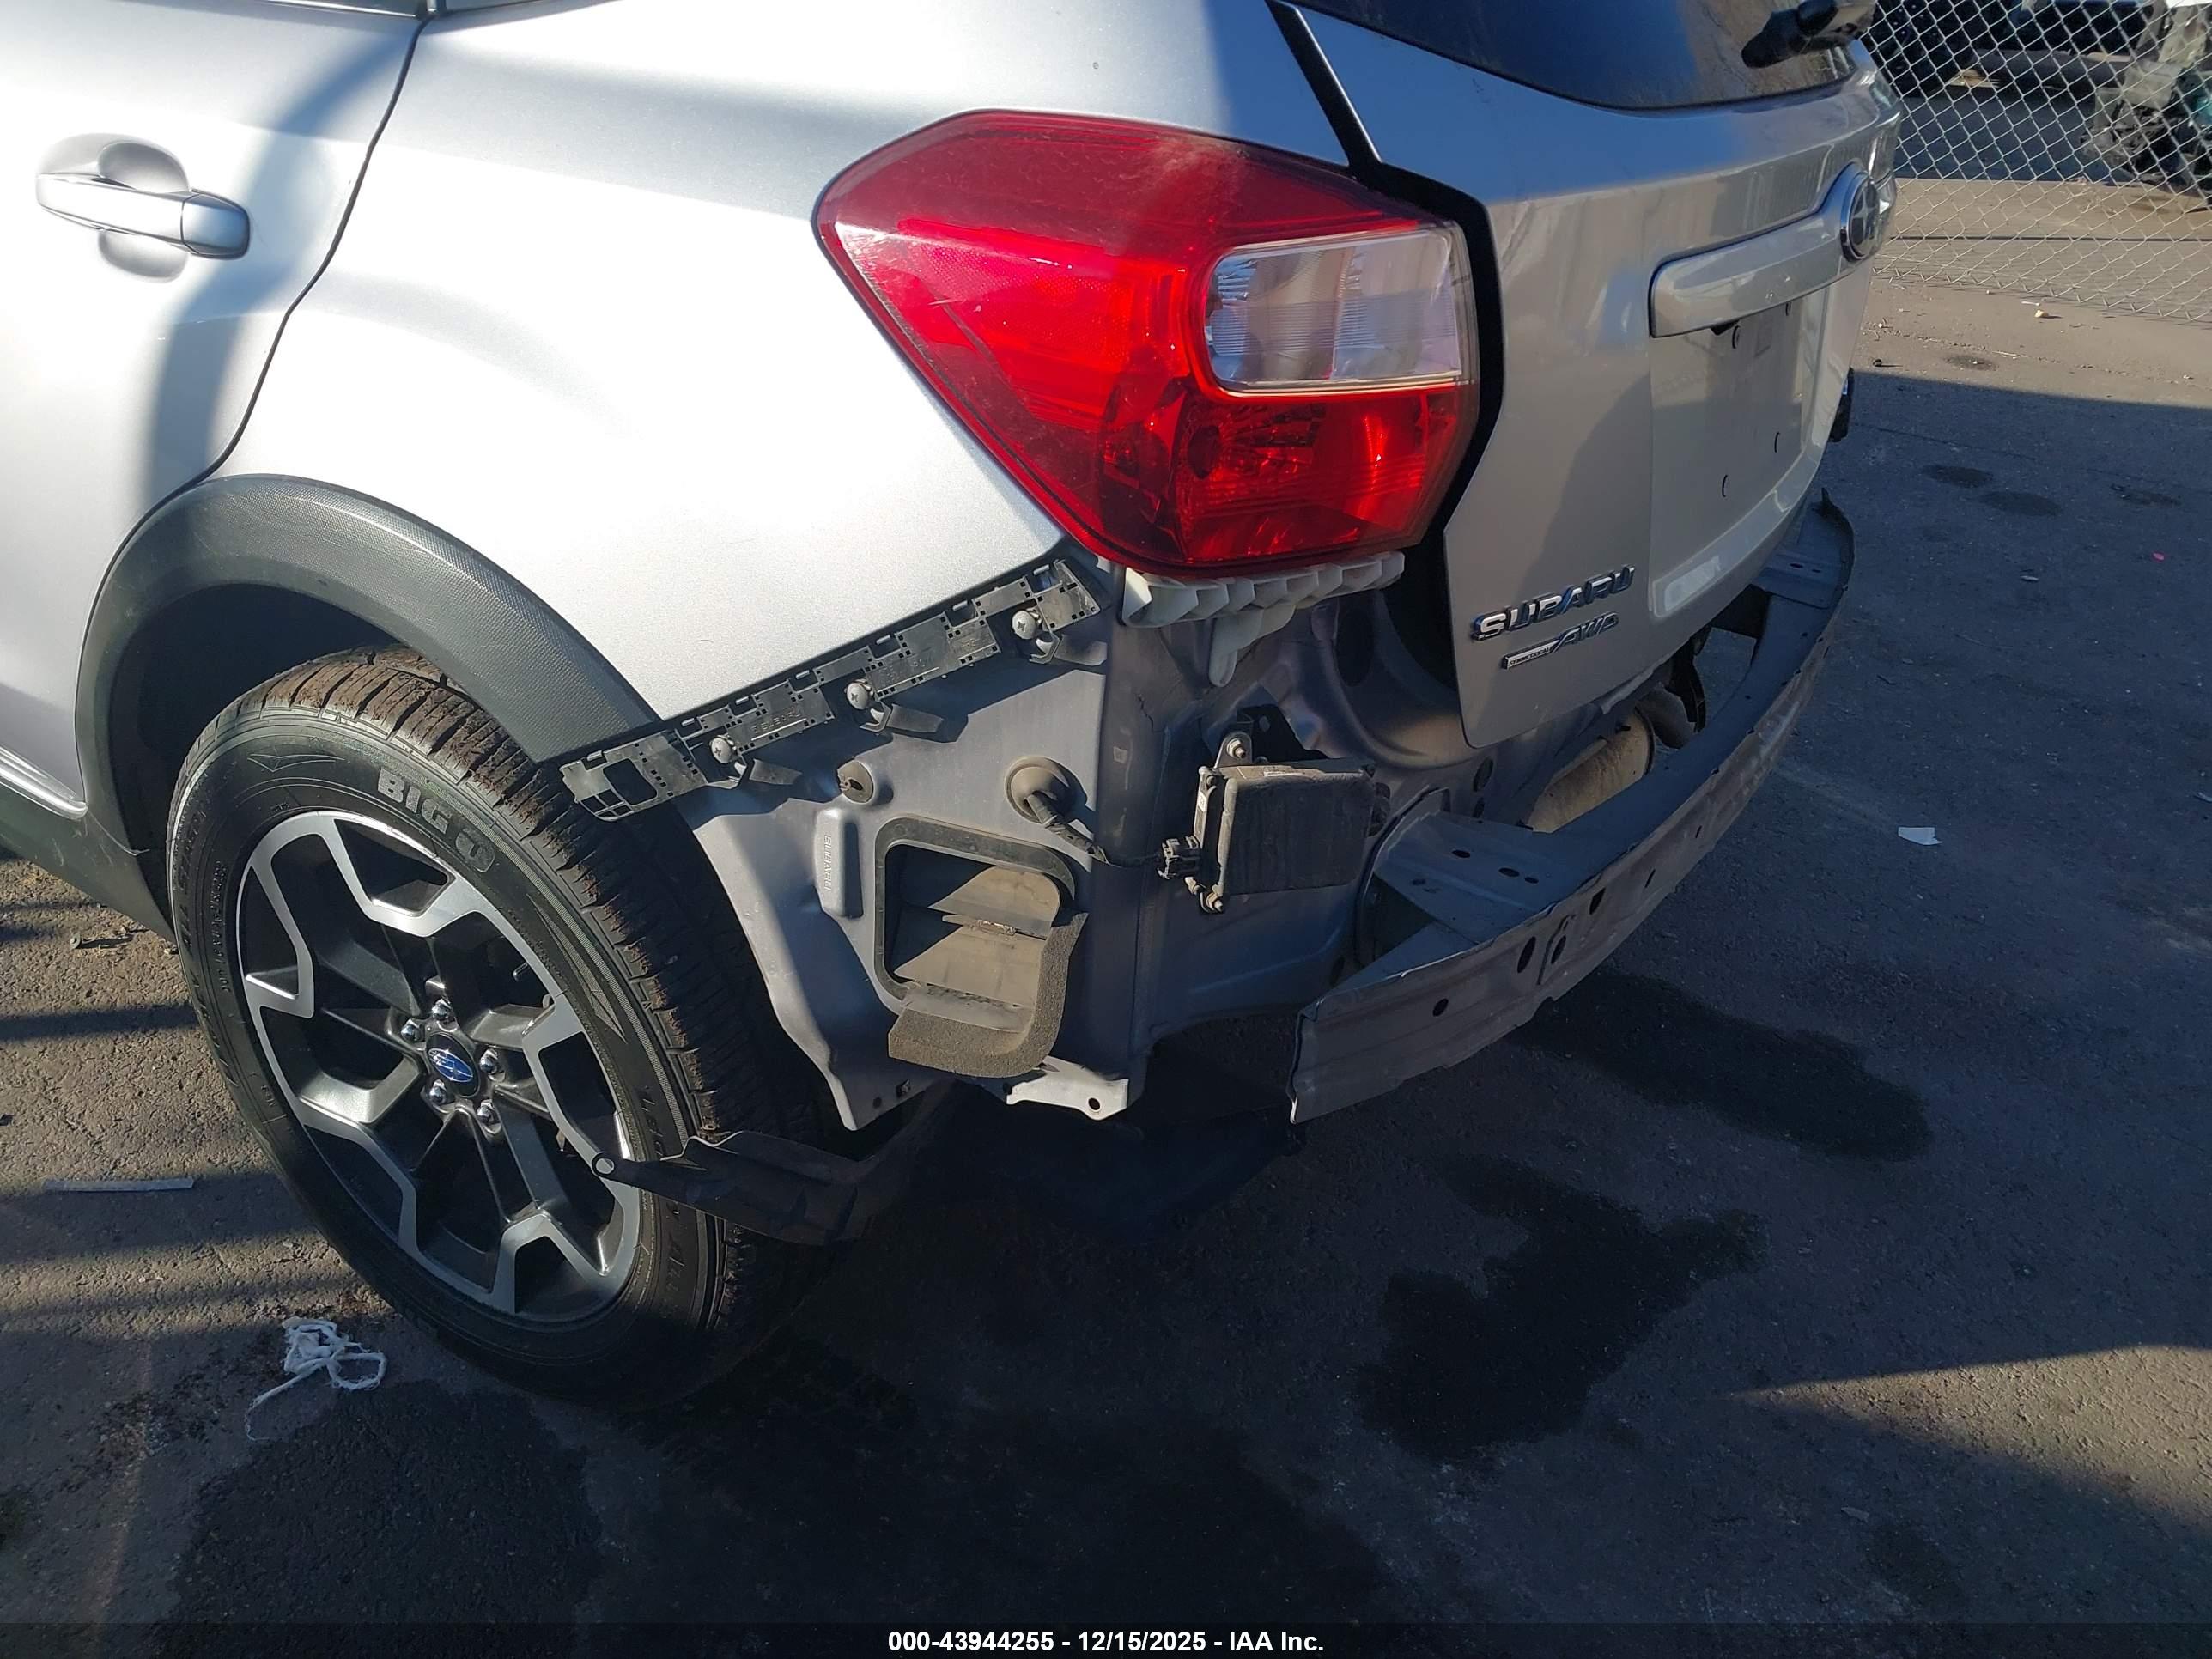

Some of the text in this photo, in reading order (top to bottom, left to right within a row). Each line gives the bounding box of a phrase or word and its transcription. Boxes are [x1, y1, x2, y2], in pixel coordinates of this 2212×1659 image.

[1470, 564, 1635, 641] SUBARU
[1553, 611, 1620, 653] AWD
[377, 767, 495, 872] BIG O
[823, 834, 833, 892] SUBARU
